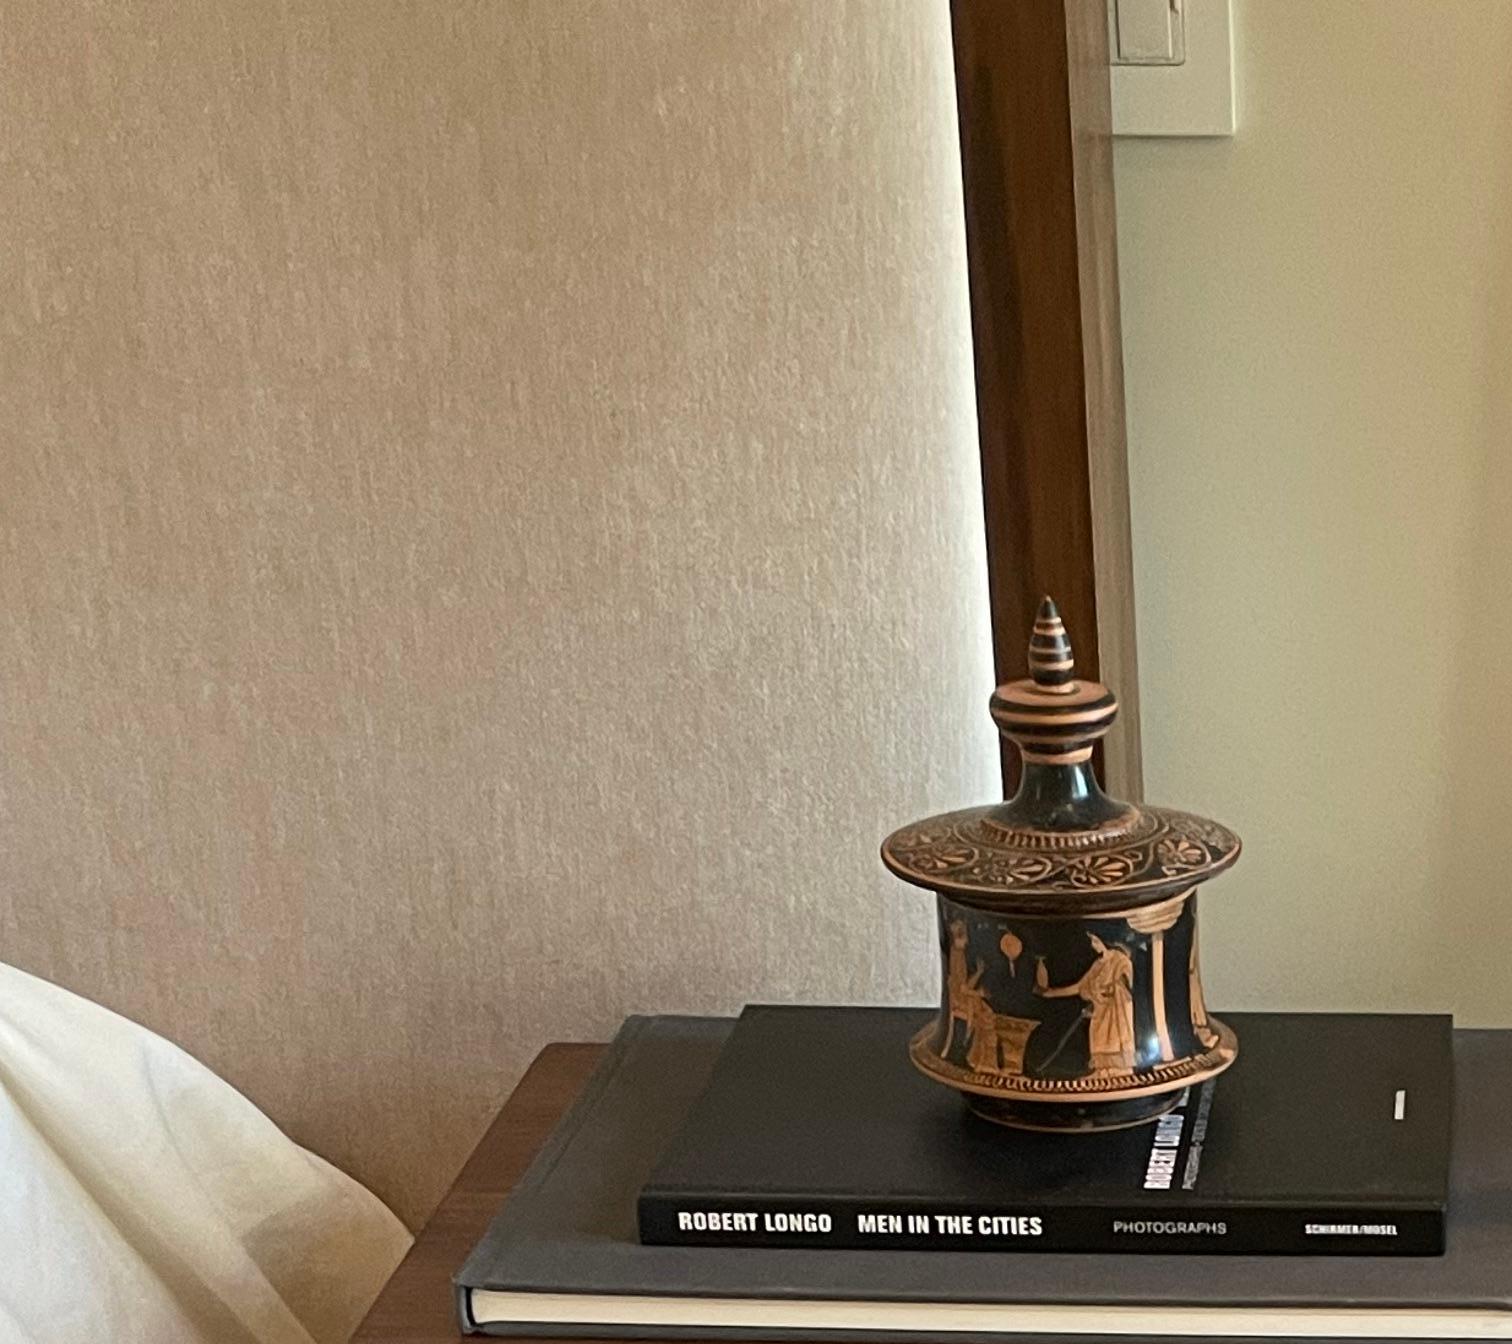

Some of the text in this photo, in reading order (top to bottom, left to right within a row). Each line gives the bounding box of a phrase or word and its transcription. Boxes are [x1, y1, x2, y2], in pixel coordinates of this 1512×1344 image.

[1143, 1148, 1178, 1190] ROBERT
[677, 1211, 1043, 1236] ROBERT LONGO MEN IN THE CITIES
[1113, 1220, 1227, 1235] PHOTOGRAPHS
